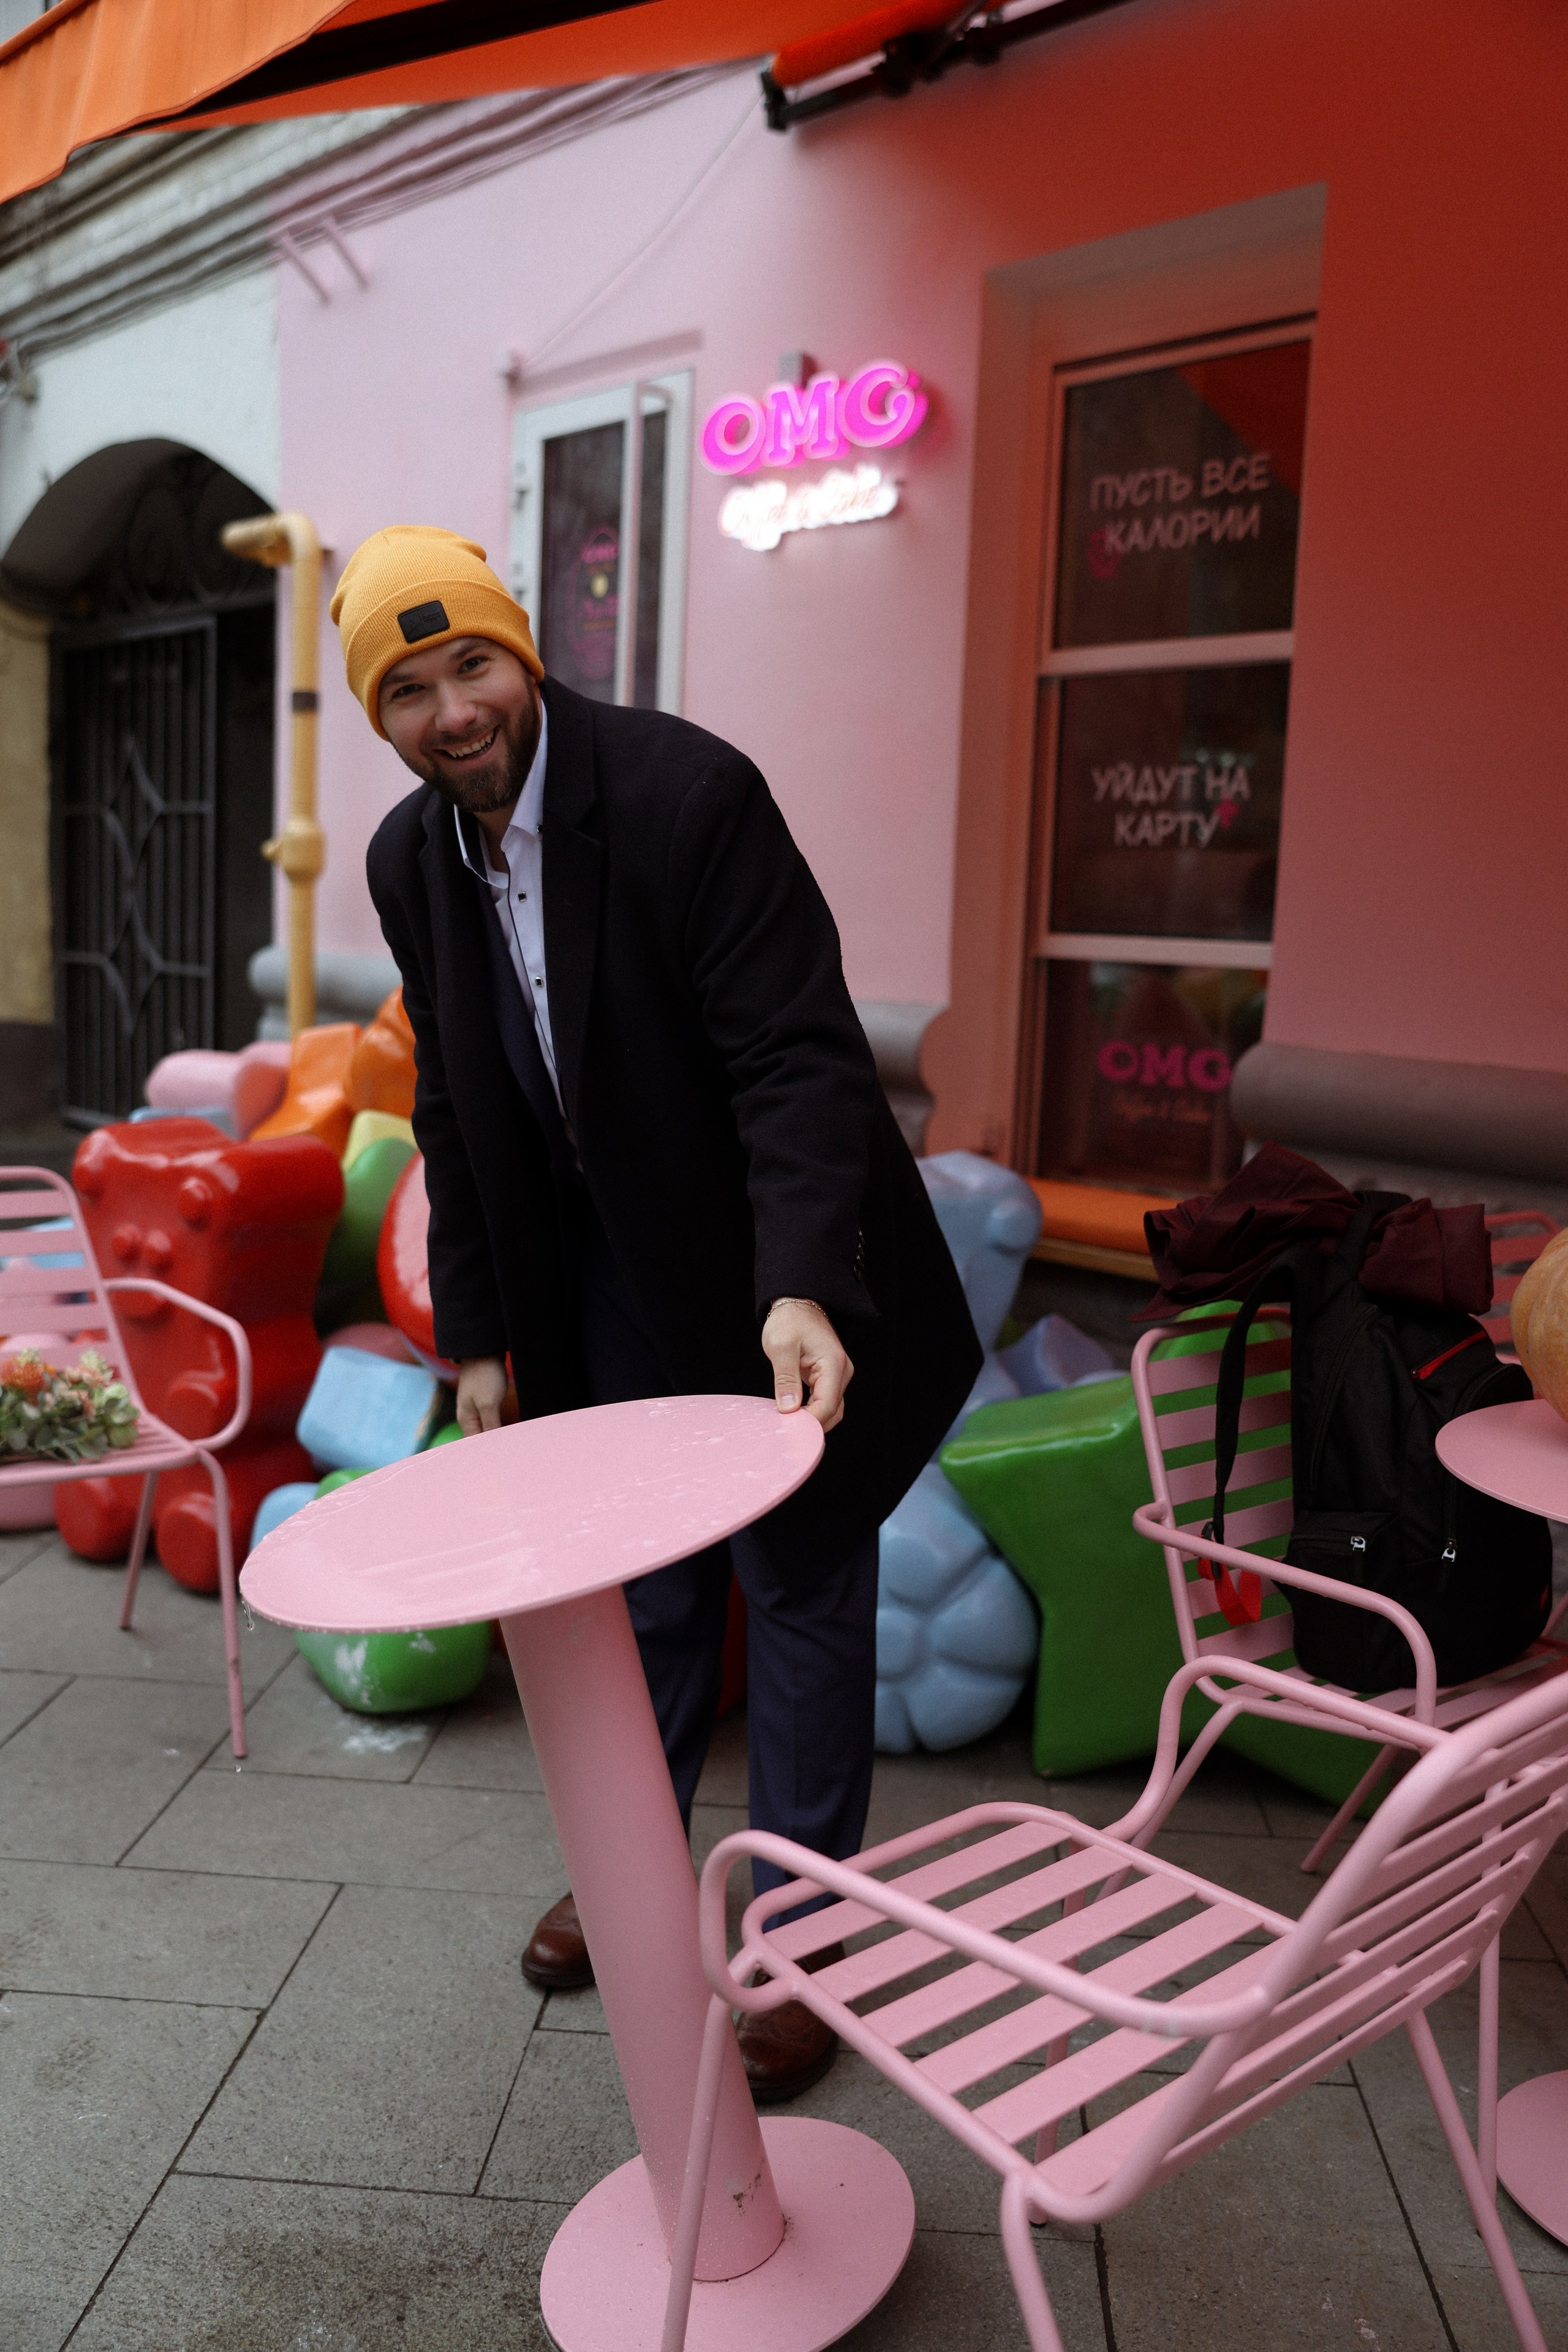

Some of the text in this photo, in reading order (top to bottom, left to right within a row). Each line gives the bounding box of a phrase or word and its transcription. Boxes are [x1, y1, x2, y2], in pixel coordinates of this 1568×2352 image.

[697, 359, 929, 477] OMG
[1091, 452, 1271, 511] ПУСТЬ ВСЕ
[1105, 503, 1261, 554] КАЛОРИИ
[1091, 762, 1251, 805] УЙДУТ НА
[1114, 810, 1221, 848] КАРТУ
